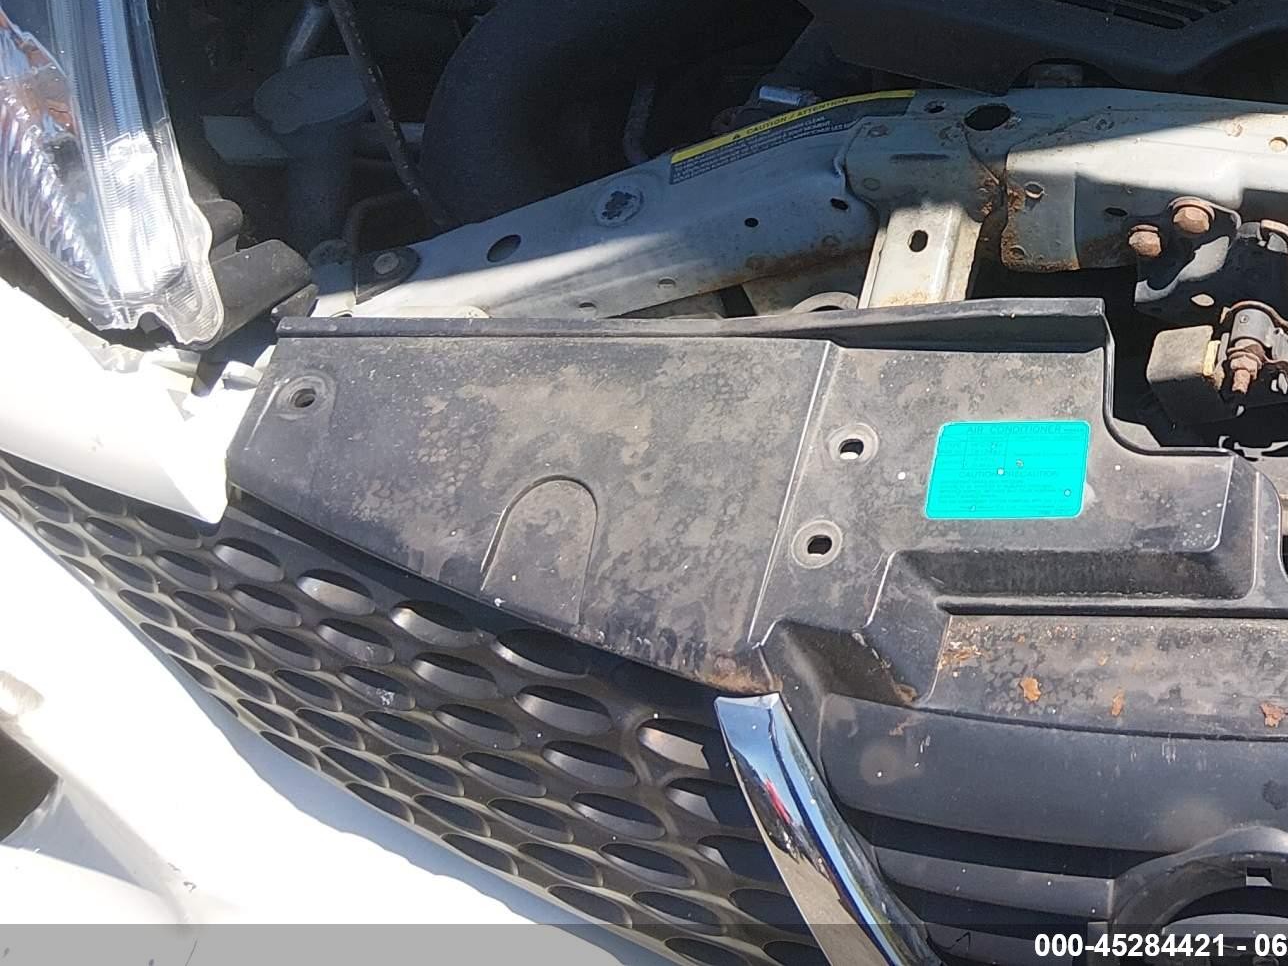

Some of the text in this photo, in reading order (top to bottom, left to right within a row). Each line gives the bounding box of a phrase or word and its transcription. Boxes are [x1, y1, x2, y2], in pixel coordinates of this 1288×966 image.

[746, 116, 787, 134] CAUTION
[796, 98, 849, 117] ATTENTION
[967, 426, 983, 434] AIR
[990, 425, 1062, 435] CONDITIONER
